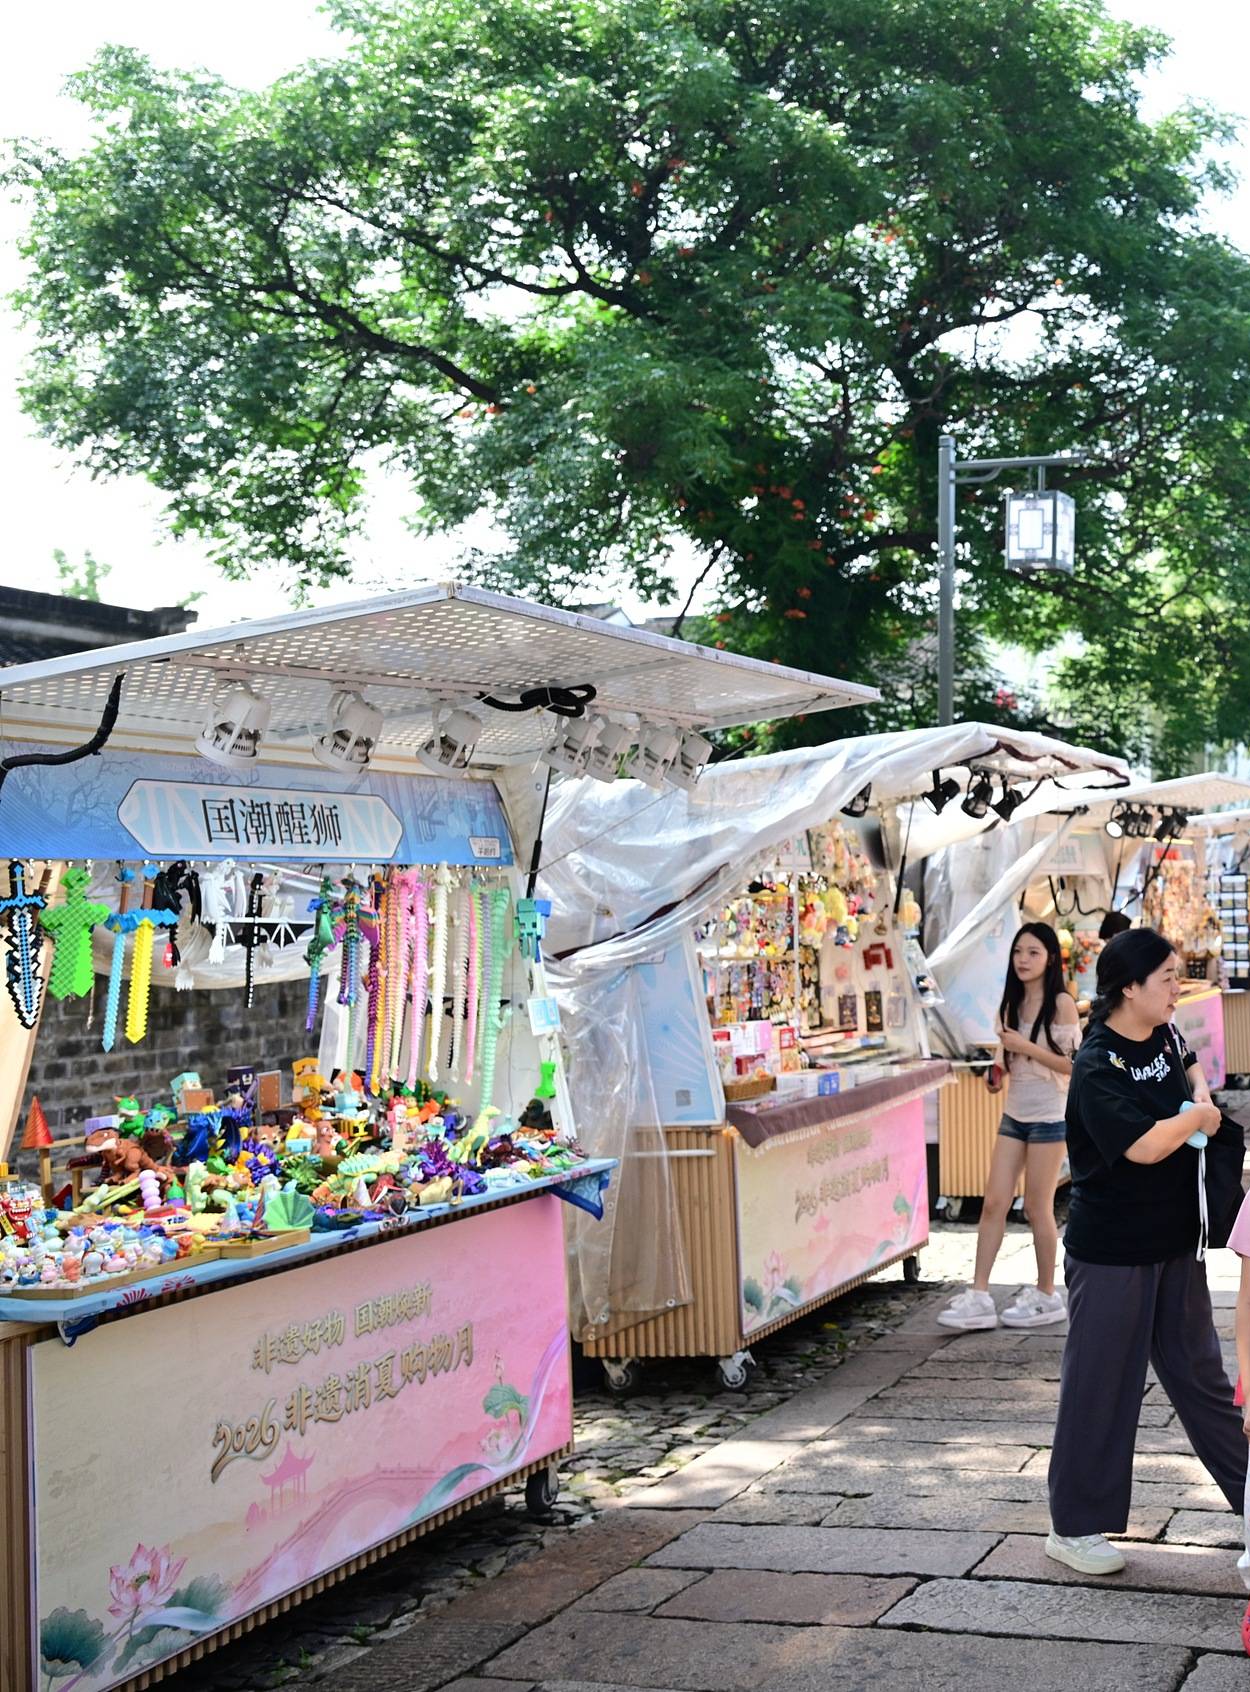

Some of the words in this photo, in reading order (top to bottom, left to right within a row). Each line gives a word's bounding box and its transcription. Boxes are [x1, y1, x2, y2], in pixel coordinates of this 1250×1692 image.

[201, 797, 343, 847] 国潮醒狮
[251, 1307, 346, 1375] 非遗好物
[354, 1281, 433, 1339] 国潮焕新
[211, 1398, 281, 1484] 2026
[283, 1321, 475, 1437] 非遗消夏购物月
